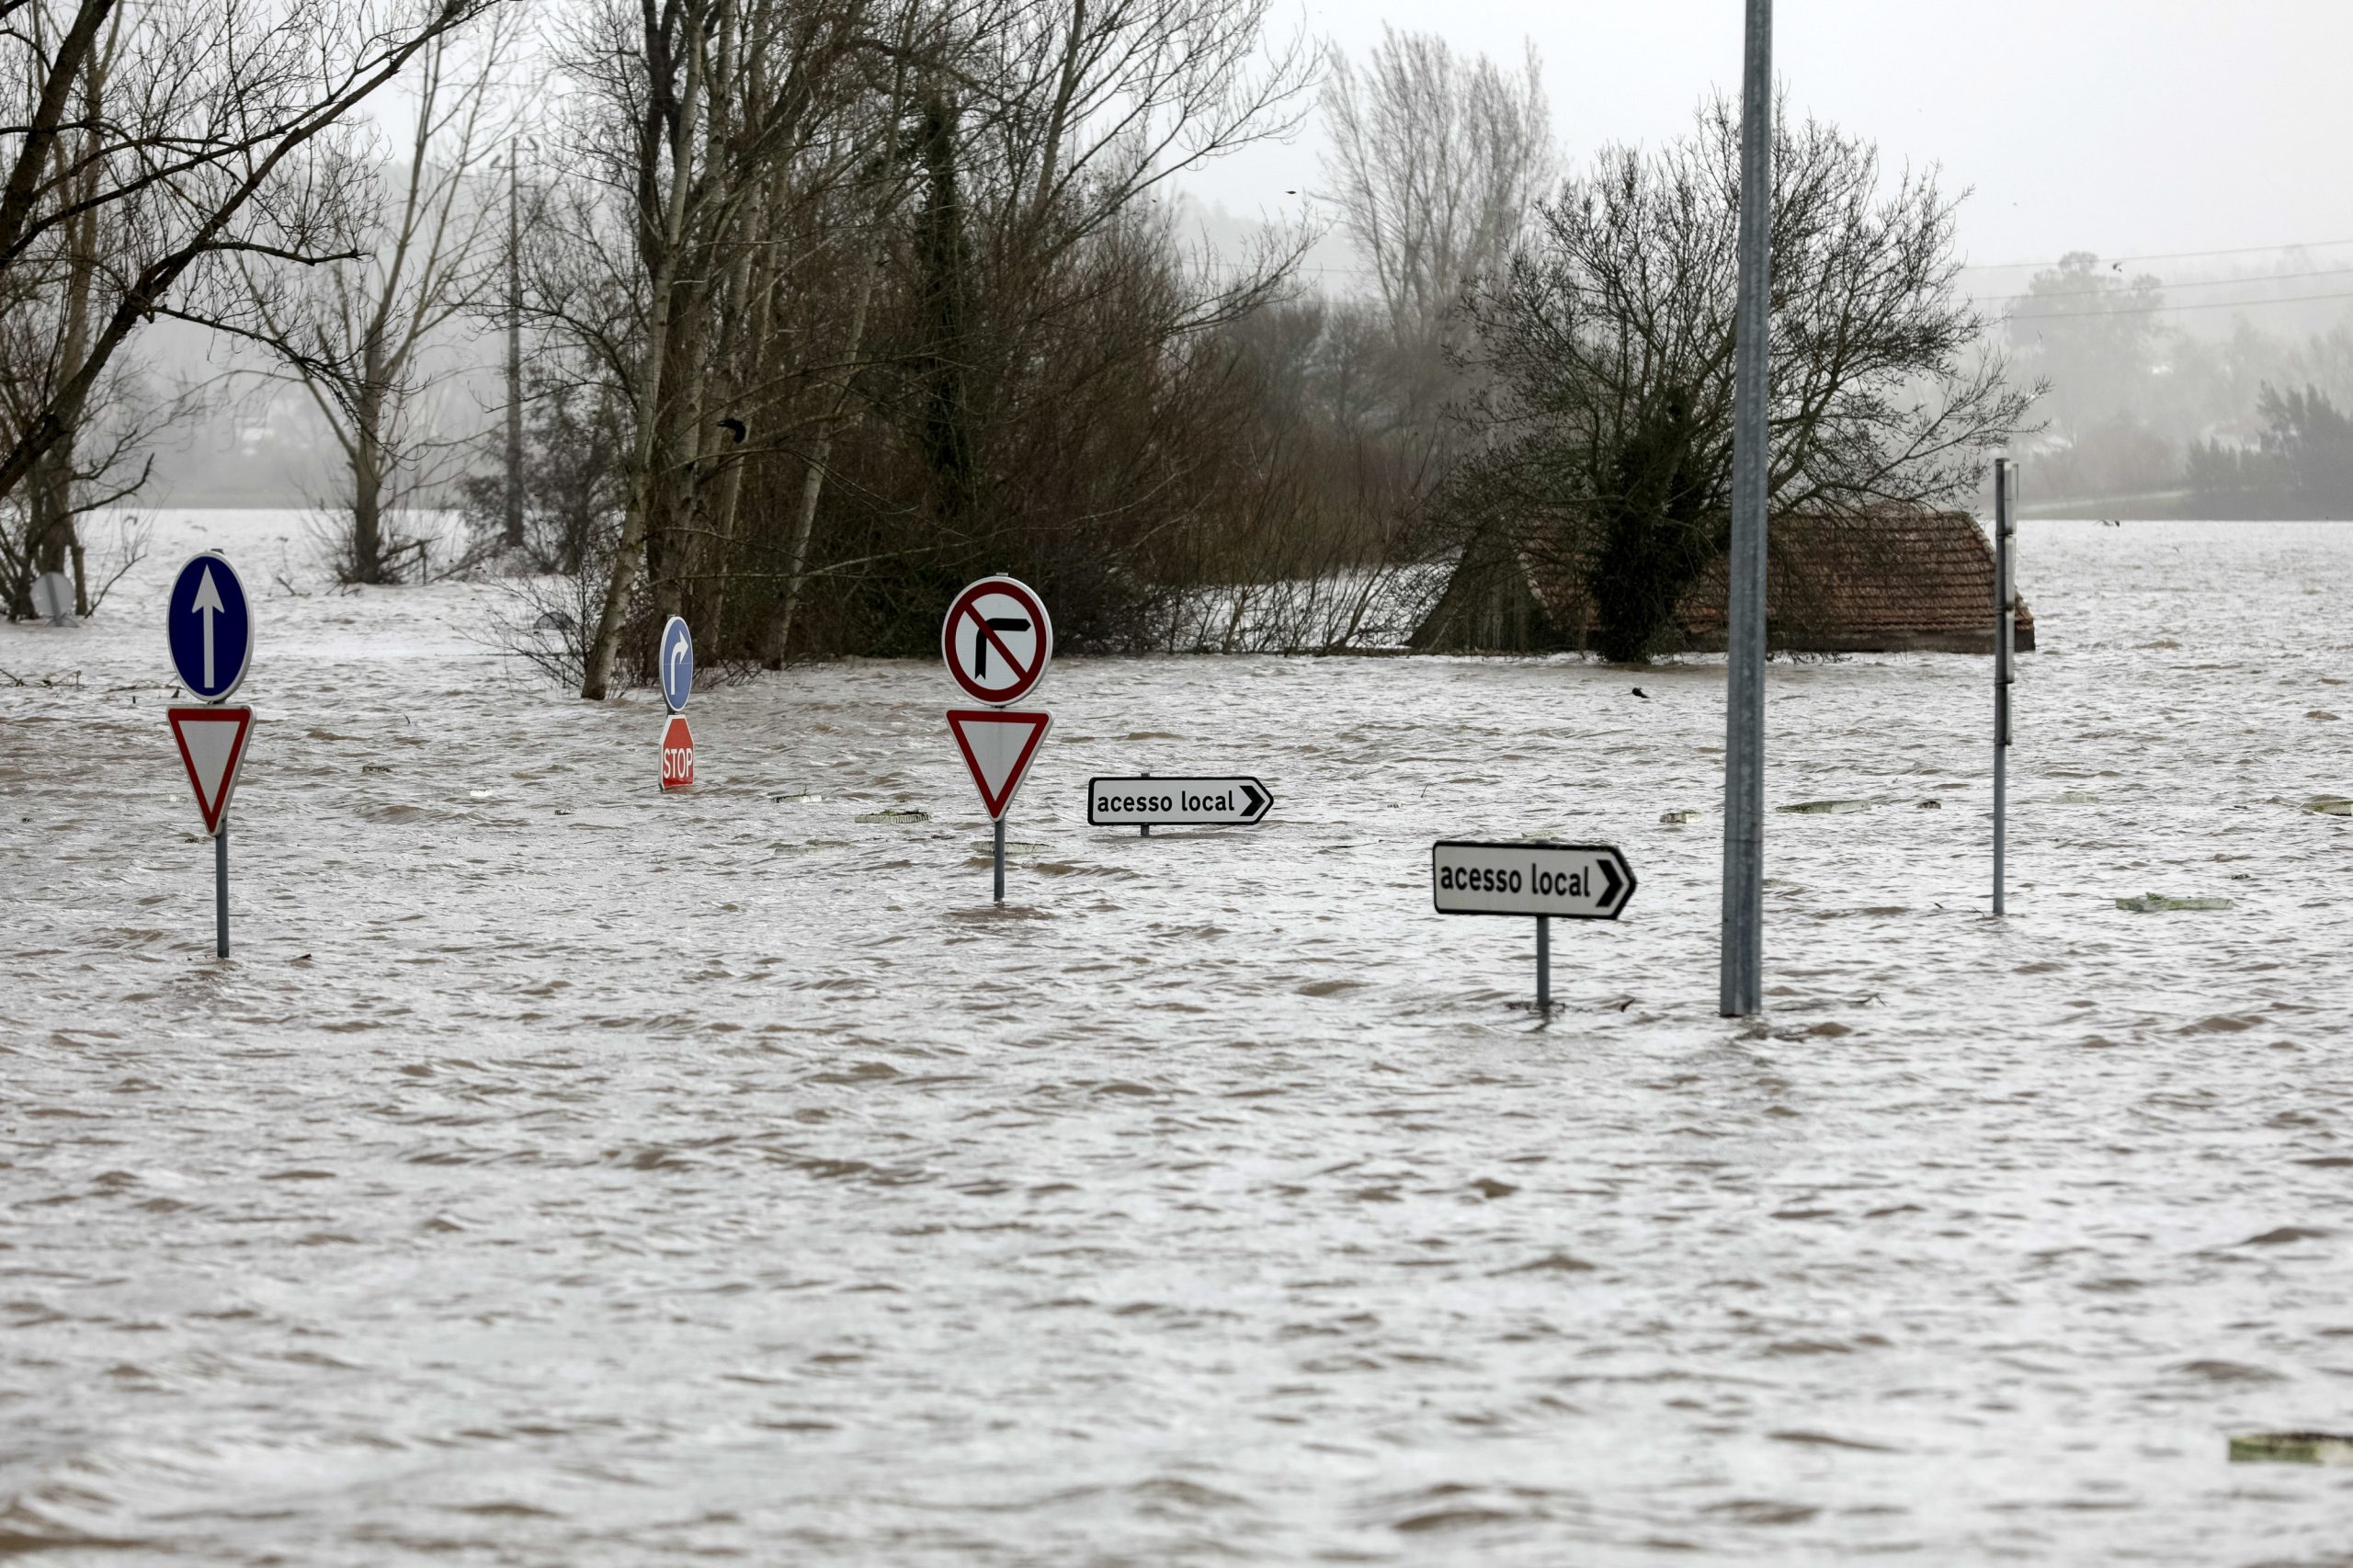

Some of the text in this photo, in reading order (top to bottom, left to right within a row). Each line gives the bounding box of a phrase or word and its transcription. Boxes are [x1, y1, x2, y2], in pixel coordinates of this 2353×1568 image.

[664, 747, 693, 779] STOP
[1097, 790, 1234, 812] acesso local
[1440, 862, 1590, 897] acesso local
